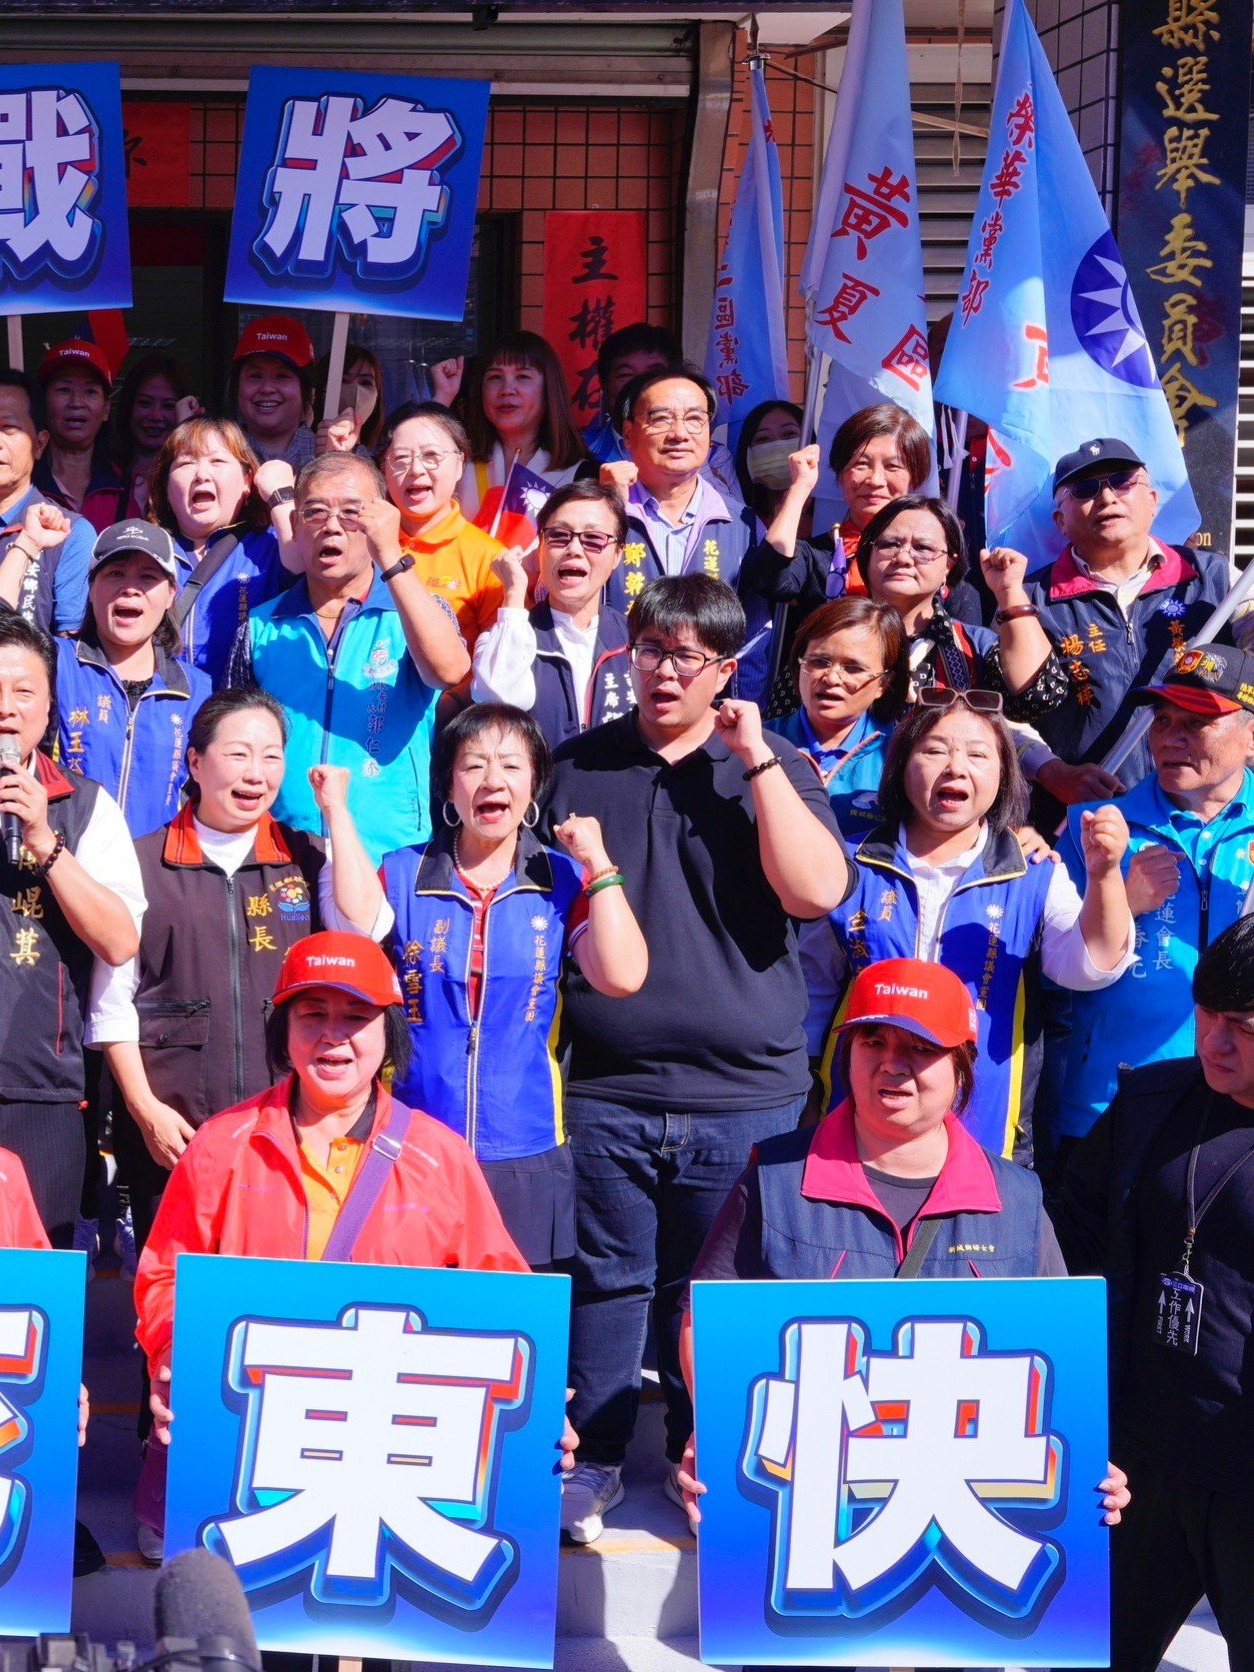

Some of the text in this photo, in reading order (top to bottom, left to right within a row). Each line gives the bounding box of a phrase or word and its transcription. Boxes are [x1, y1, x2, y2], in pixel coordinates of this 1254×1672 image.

[264, 96, 454, 264] 將
[59, 348, 91, 358] Taiwan
[256, 332, 288, 342] Taiwan
[1088, 623, 1108, 653] 主任
[247, 893, 277, 952] 縣長
[430, 918, 450, 974] 副議長
[1152, 895, 1177, 971] 蓮會長
[306, 955, 355, 968] Taiwan
[403, 940, 424, 1025] 徐雪玉
[875, 983, 929, 999] Taiwan
[1166, 1287, 1182, 1346] 工作優先
[216, 1309, 518, 1583] 東
[757, 1322, 1048, 1592] 快
